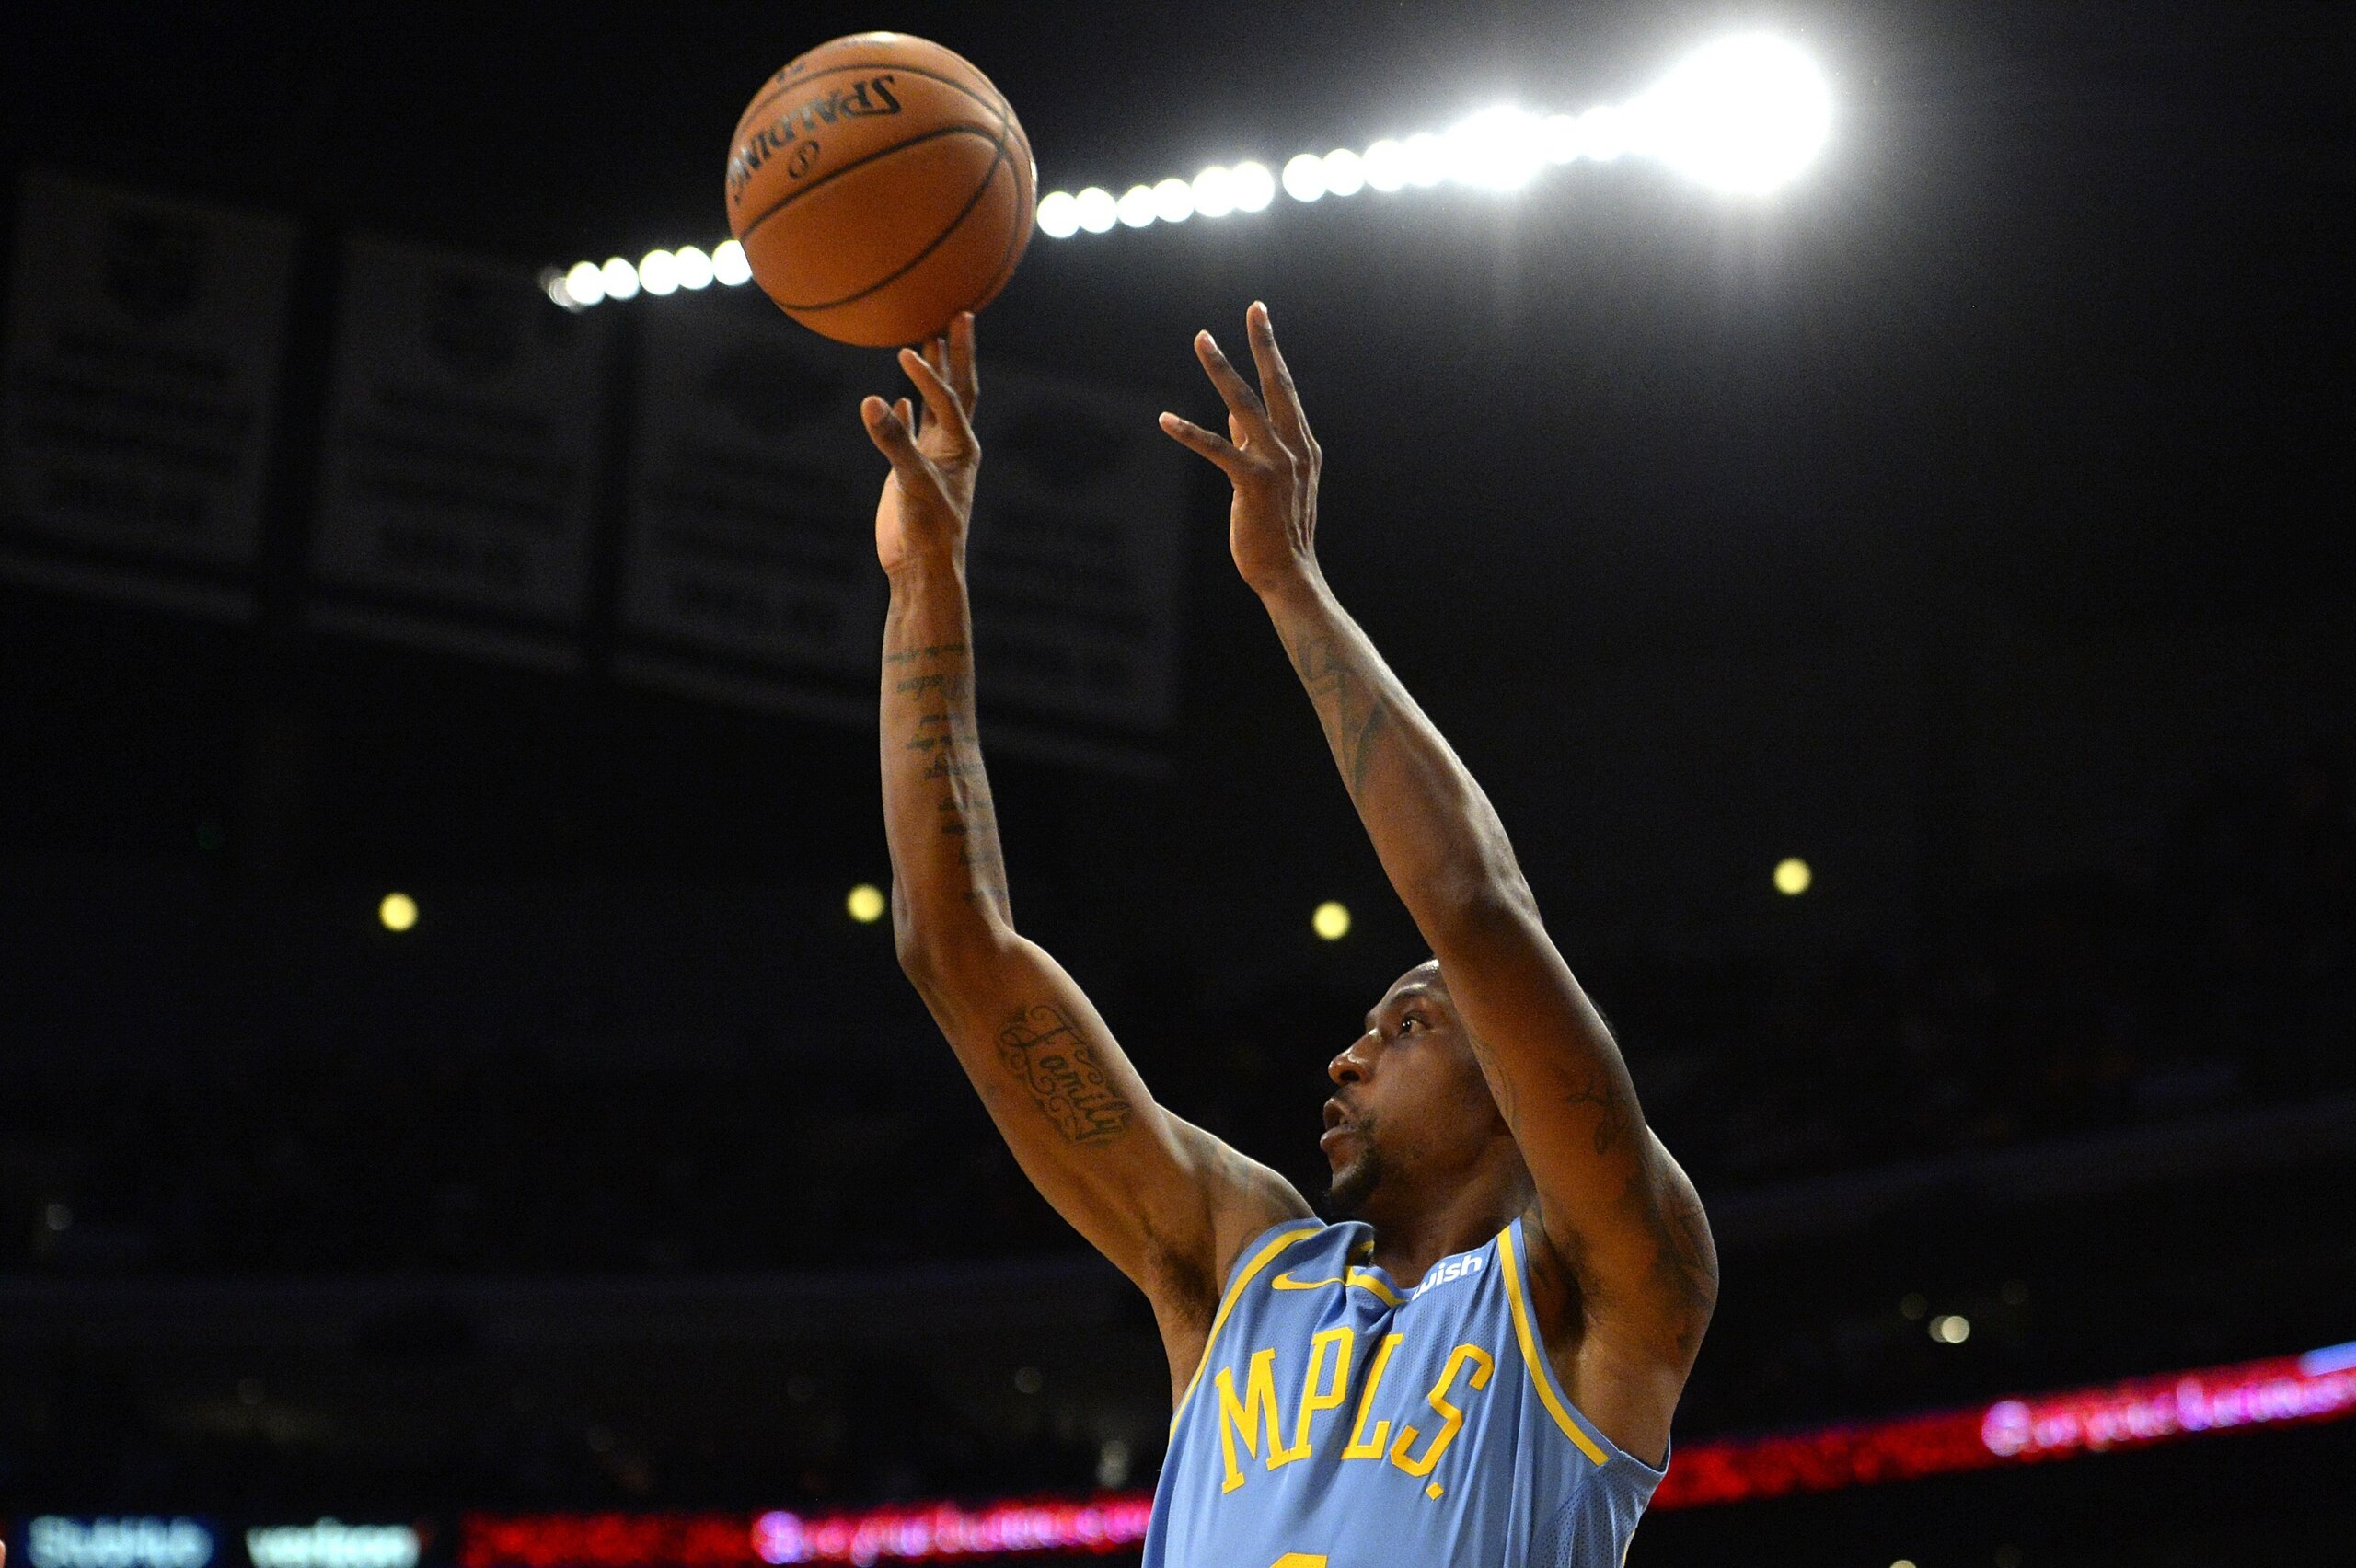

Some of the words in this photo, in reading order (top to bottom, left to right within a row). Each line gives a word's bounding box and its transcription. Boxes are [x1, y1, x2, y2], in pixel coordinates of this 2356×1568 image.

[725, 74, 903, 204] SPALDING
[1411, 1254, 1483, 1301] wish
[1214, 1327, 1495, 1502] MPLS.
